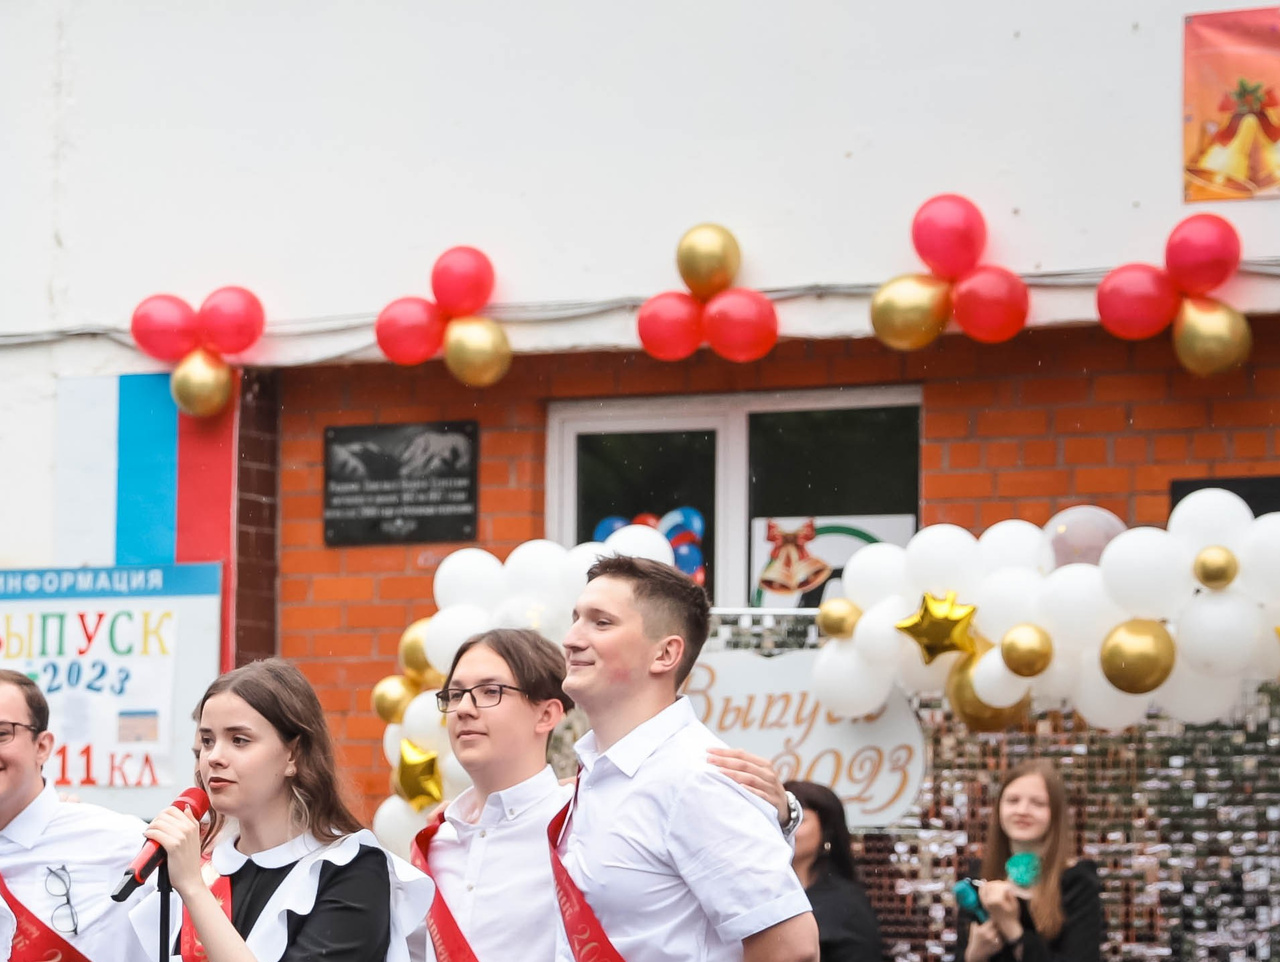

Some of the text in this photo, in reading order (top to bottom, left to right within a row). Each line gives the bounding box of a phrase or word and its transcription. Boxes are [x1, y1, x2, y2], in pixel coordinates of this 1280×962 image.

[42, 660, 132, 696] 2023
[676, 662, 888, 750] Выпу
[54, 743, 98, 787] 11
